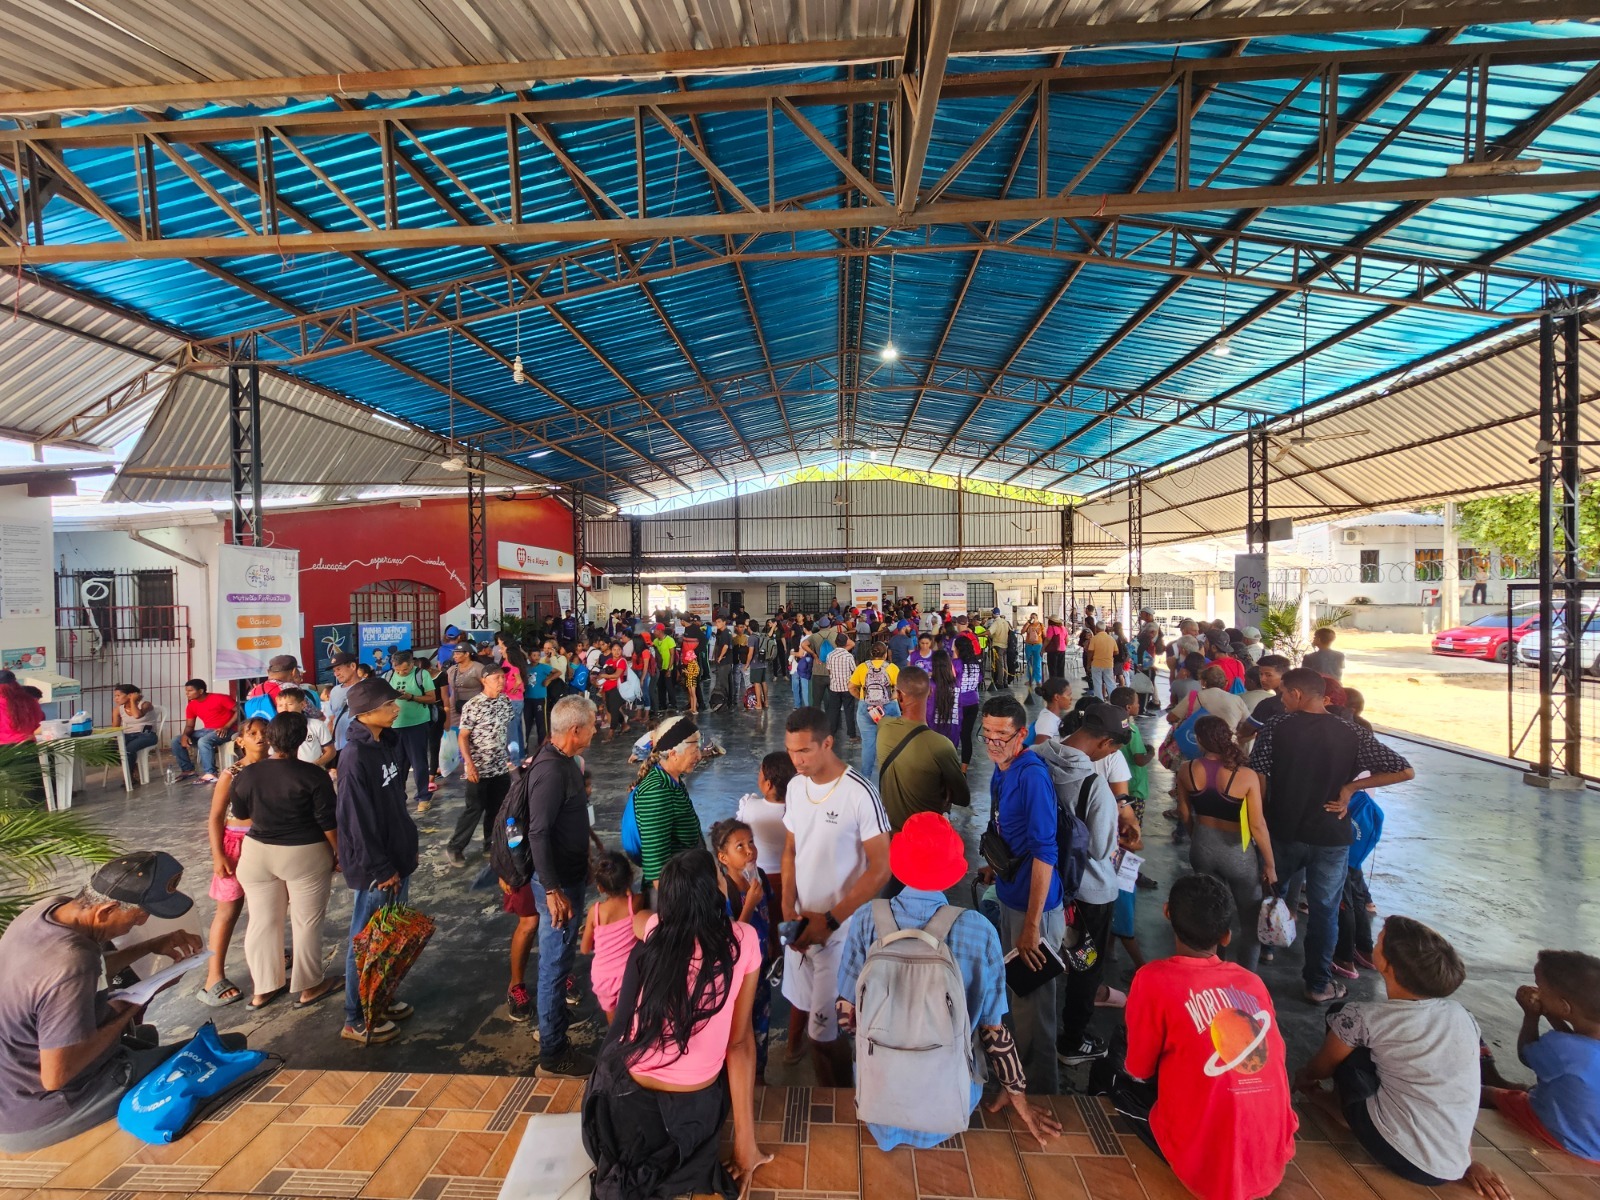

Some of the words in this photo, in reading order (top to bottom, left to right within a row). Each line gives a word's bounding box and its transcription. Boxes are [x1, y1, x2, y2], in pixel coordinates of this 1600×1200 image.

[312, 558, 347, 572] educação
[370, 556, 404, 569] esperança
[535, 557, 549, 566] Alegria
[259, 565, 270, 576] Pop
[1250, 576, 1262, 592] Pop
[249, 617, 271, 625] Banho
[362, 633, 375, 641] VEM
[377, 633, 403, 641] PRIMEIRO
